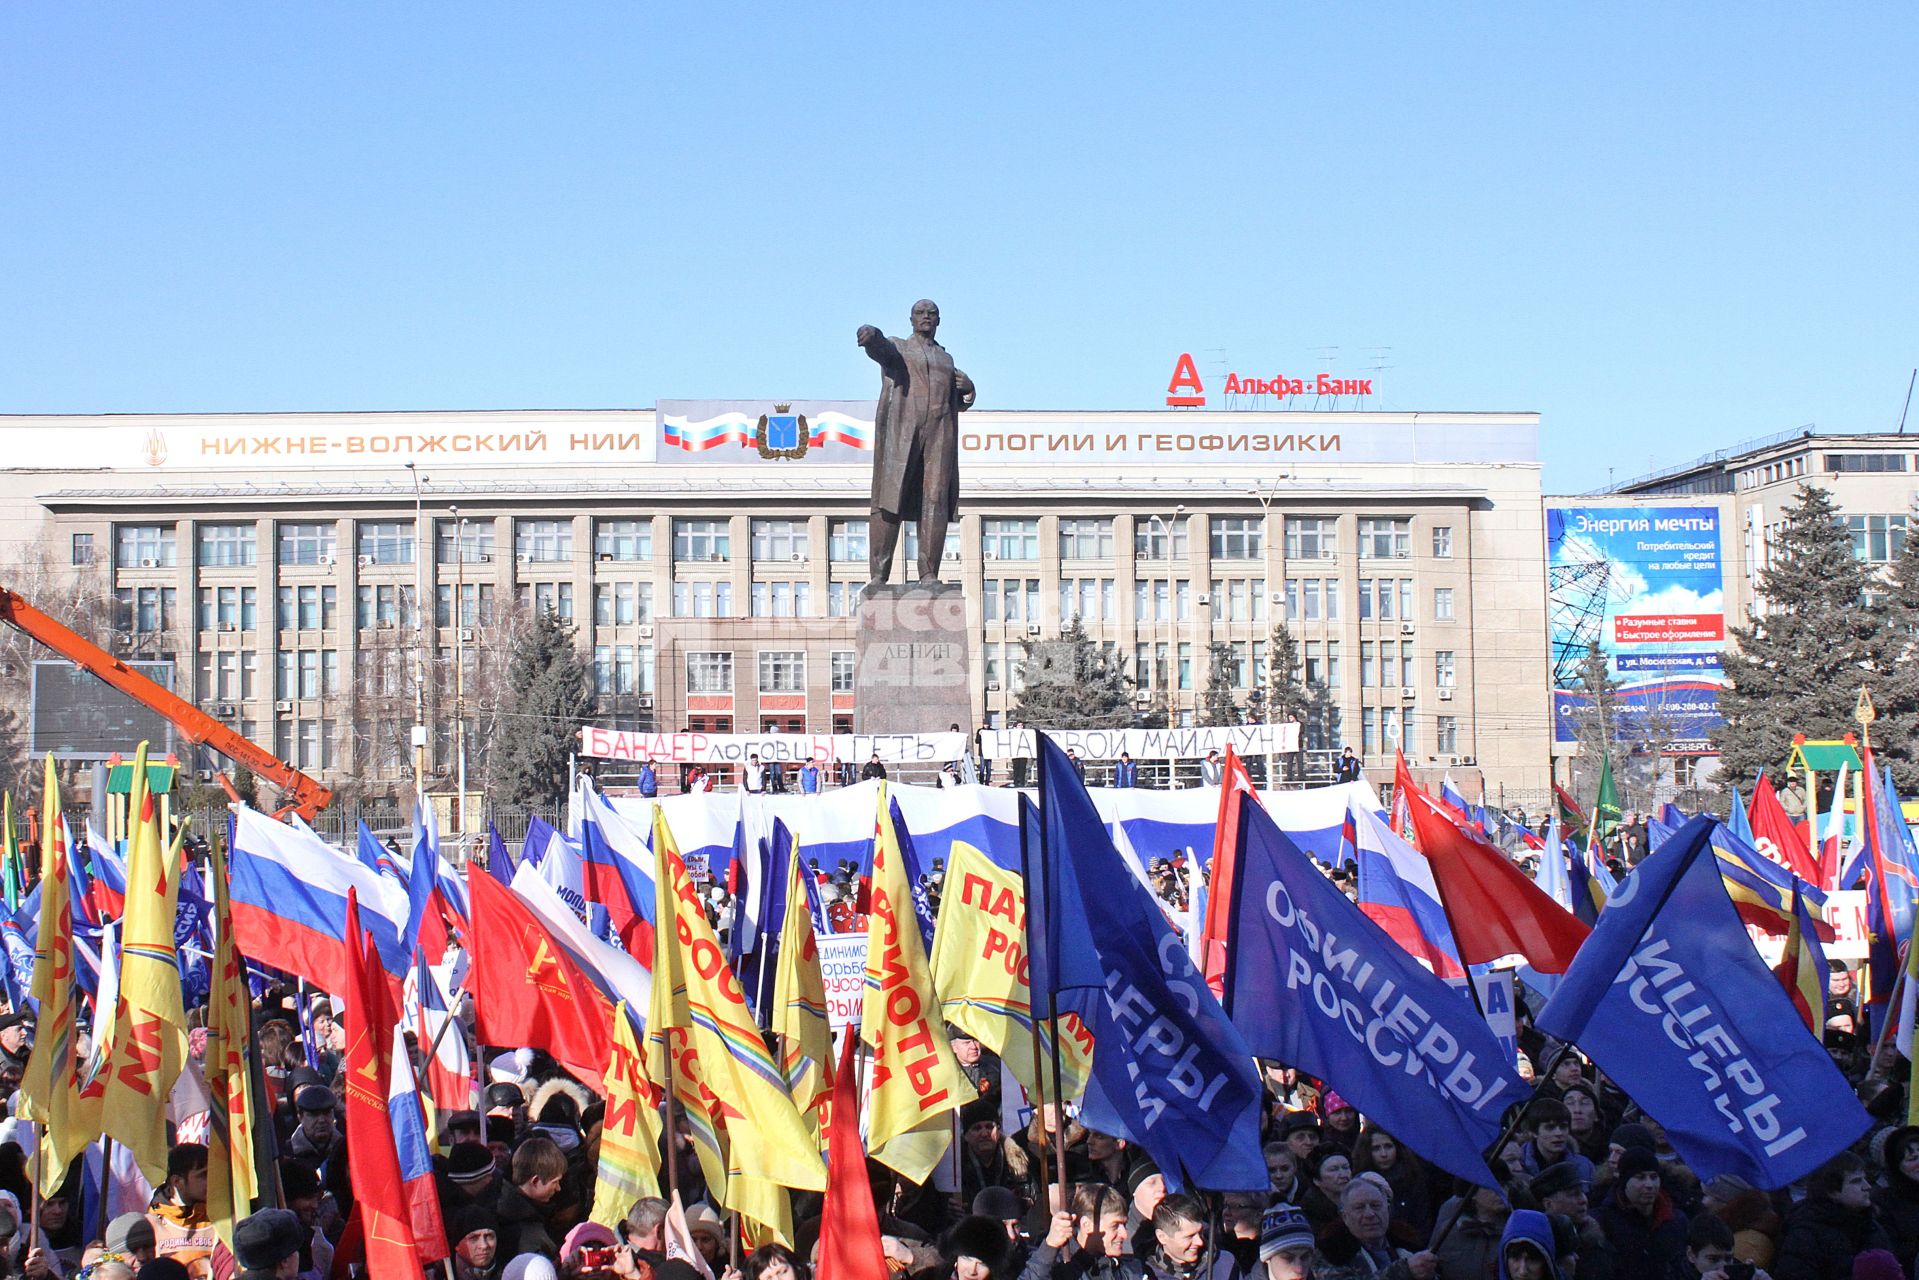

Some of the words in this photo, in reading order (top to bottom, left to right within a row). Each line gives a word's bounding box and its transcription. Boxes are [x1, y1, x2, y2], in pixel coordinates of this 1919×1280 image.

[201, 430, 548, 455] НИЖНЕ-ВОЛЖСКИЙ
[570, 433, 641, 451] НИИ
[962, 434, 1094, 452] ОЛОГИИ
[1105, 434, 1127, 451] И
[1138, 434, 1341, 452] ГЕОФИЗИКИ
[1576, 515, 1649, 536] Энергия
[1655, 517, 1714, 531] мечты
[1637, 541, 1715, 553] Потребительский
[1684, 552, 1715, 563] кредит
[1662, 562, 1692, 570] любые
[1693, 562, 1716, 571] цели
[1622, 618, 1666, 629] Разумные
[1668, 618, 1697, 626] ставки
[1623, 630, 1660, 641] Быстрое
[1662, 630, 1716, 641] оформление
[884, 643, 950, 660] ЛЕНИН
[1625, 658, 1638, 668] ул.
[1705, 656, 1717, 665] 66
[852, 735, 936, 762] ГЕТЬ
[996, 730, 1034, 758] НА
